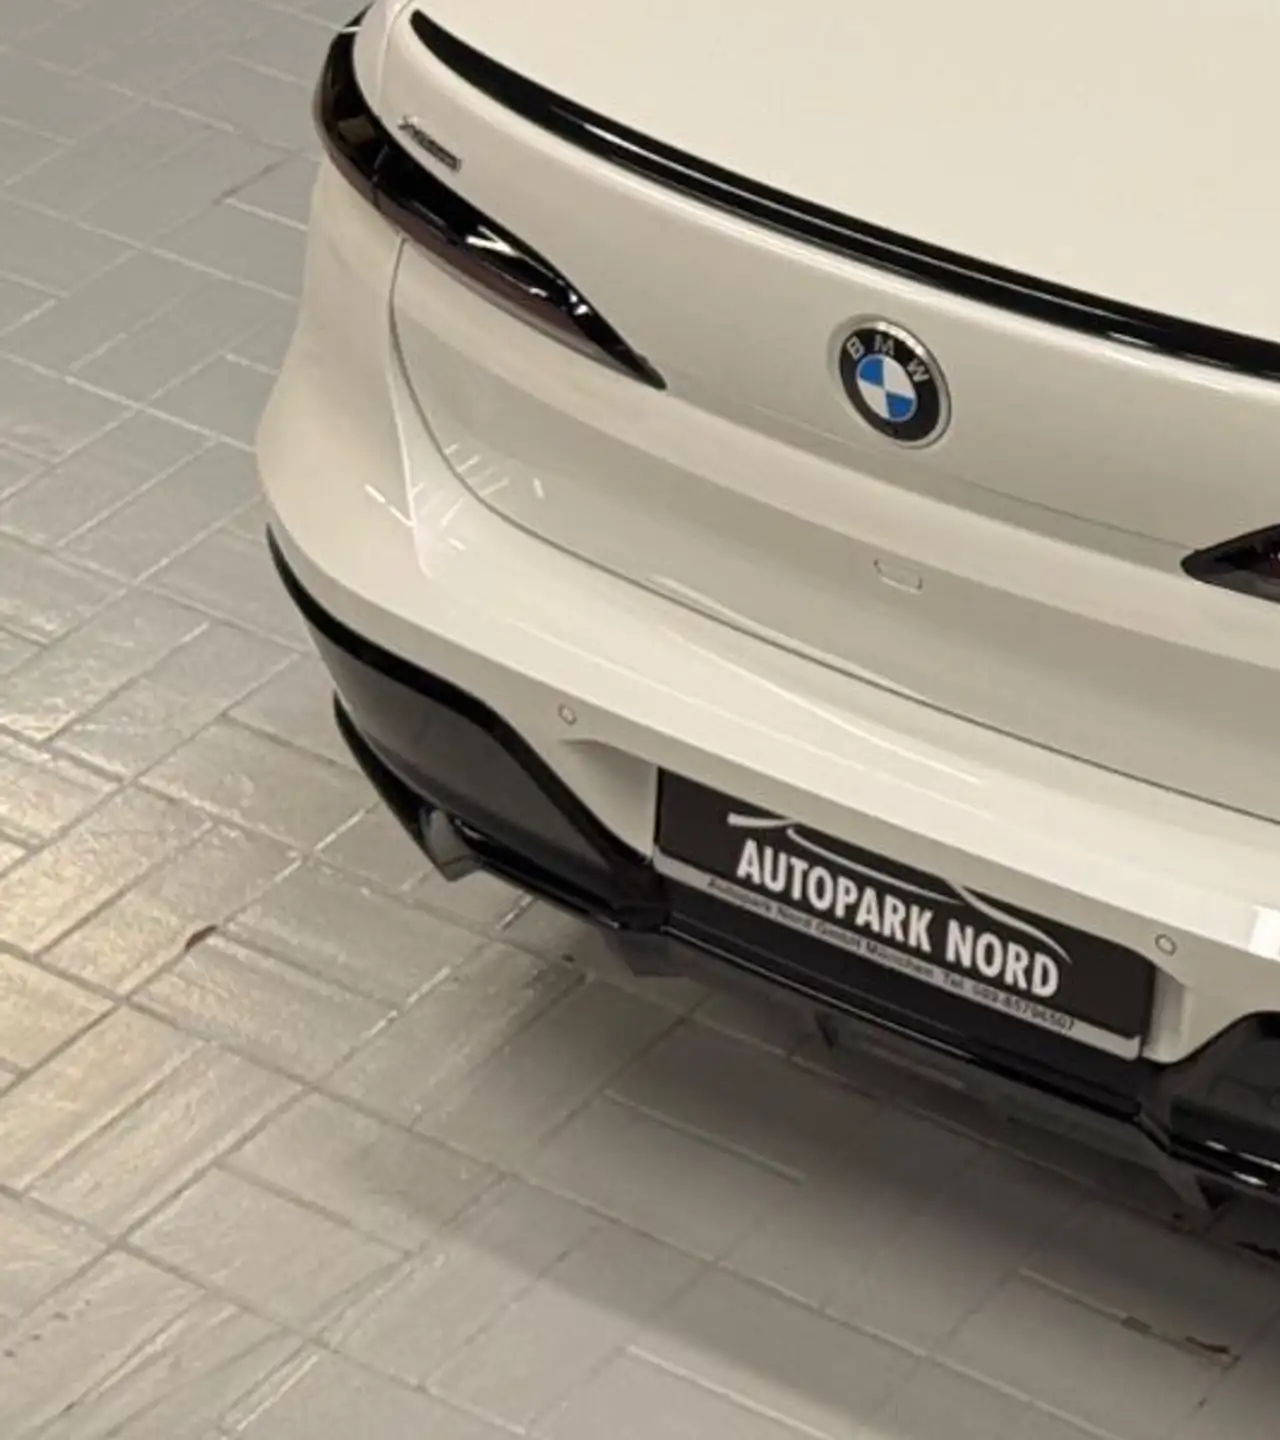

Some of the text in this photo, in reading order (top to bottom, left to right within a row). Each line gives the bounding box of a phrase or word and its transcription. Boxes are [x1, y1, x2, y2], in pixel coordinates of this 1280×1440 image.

[846, 333, 931, 384] BMW
[735, 839, 1060, 998] AUTOPARK NORD
